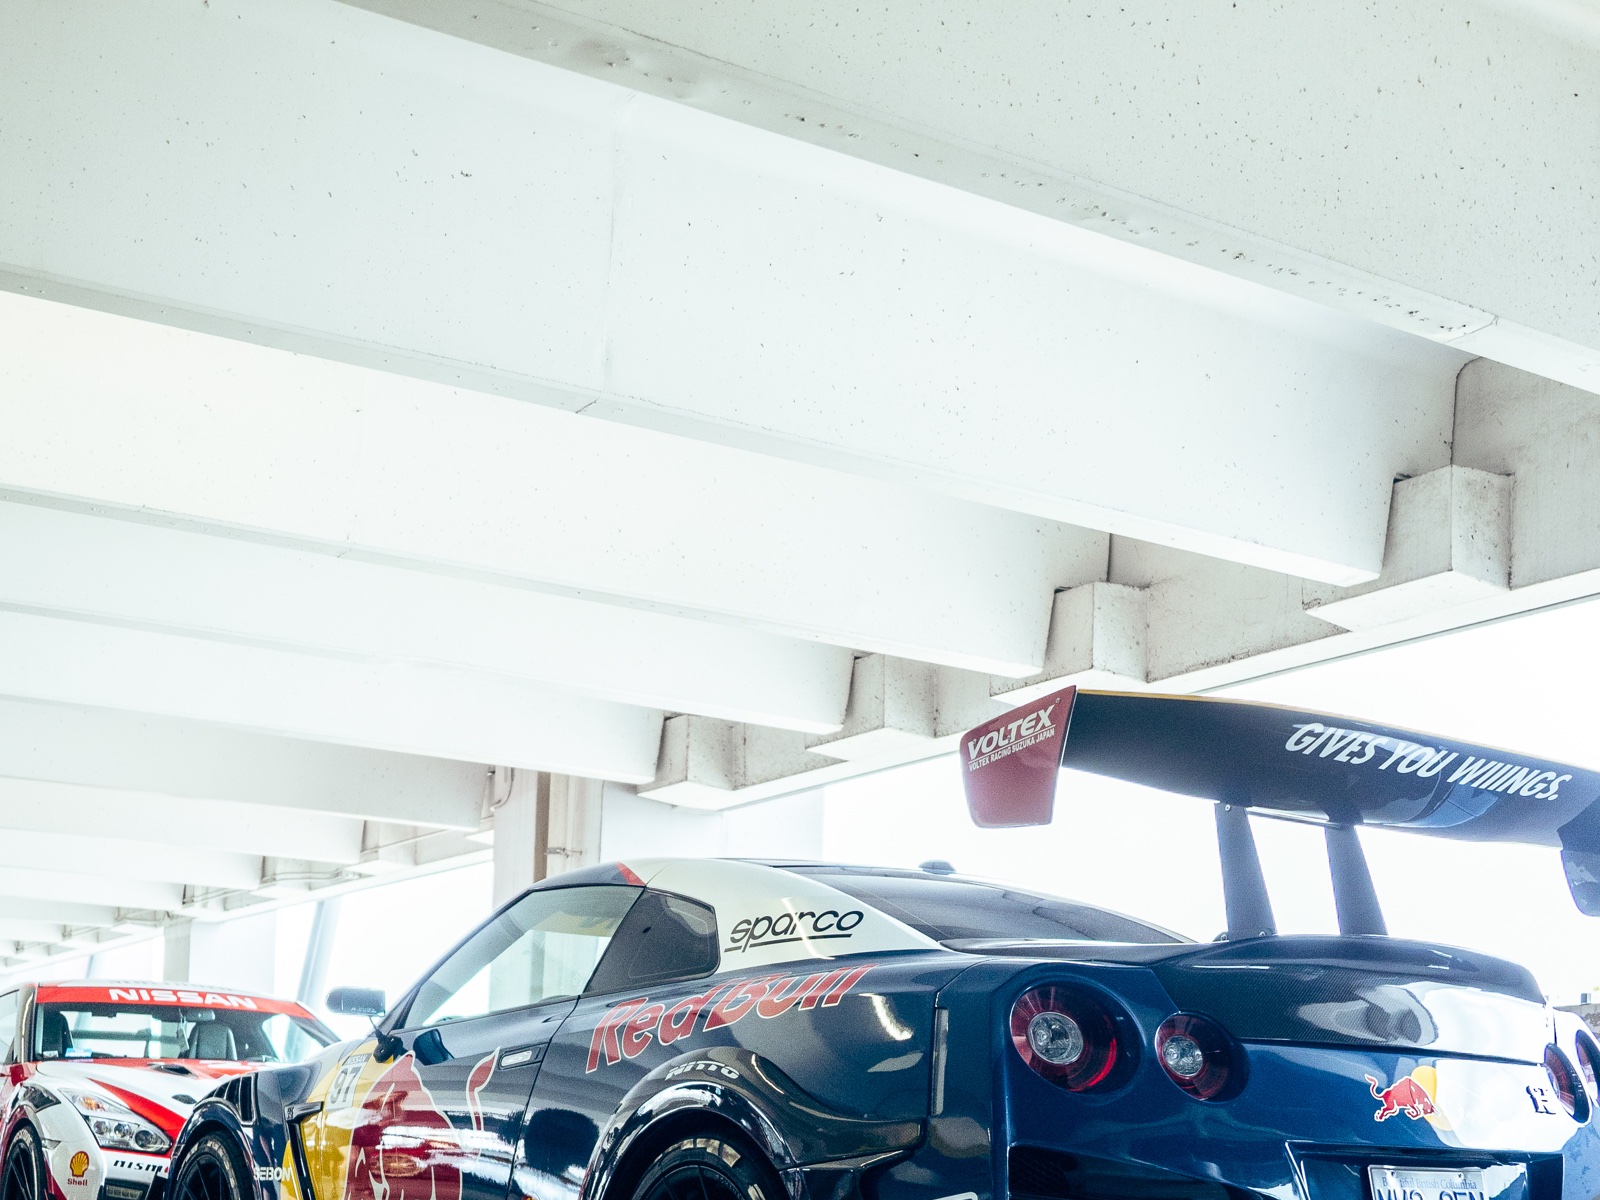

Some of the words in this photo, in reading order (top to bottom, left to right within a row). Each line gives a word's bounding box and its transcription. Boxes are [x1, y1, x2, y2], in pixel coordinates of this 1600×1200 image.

[968, 704, 1055, 760] VOLTEX
[968, 757, 990, 772] VOLTEX
[990, 746, 1012, 762] RACING
[1012, 736, 1035, 753] SUZUKA
[1036, 727, 1055, 743] JAPAN
[1285, 722, 1389, 765] GIVES
[1378, 741, 1459, 778] YOU
[1447, 756, 1573, 801] WIIINGS.
[727, 910, 865, 953] sparco
[108, 988, 258, 1010] NISSAN
[586, 977, 746, 1074] Red
[703, 963, 880, 1033] Bull
[330, 1066, 363, 1105] 97
[665, 1060, 740, 1081] NITTO
[67, 1178, 88, 1187] Shell
[253, 1166, 292, 1182] SEBON
